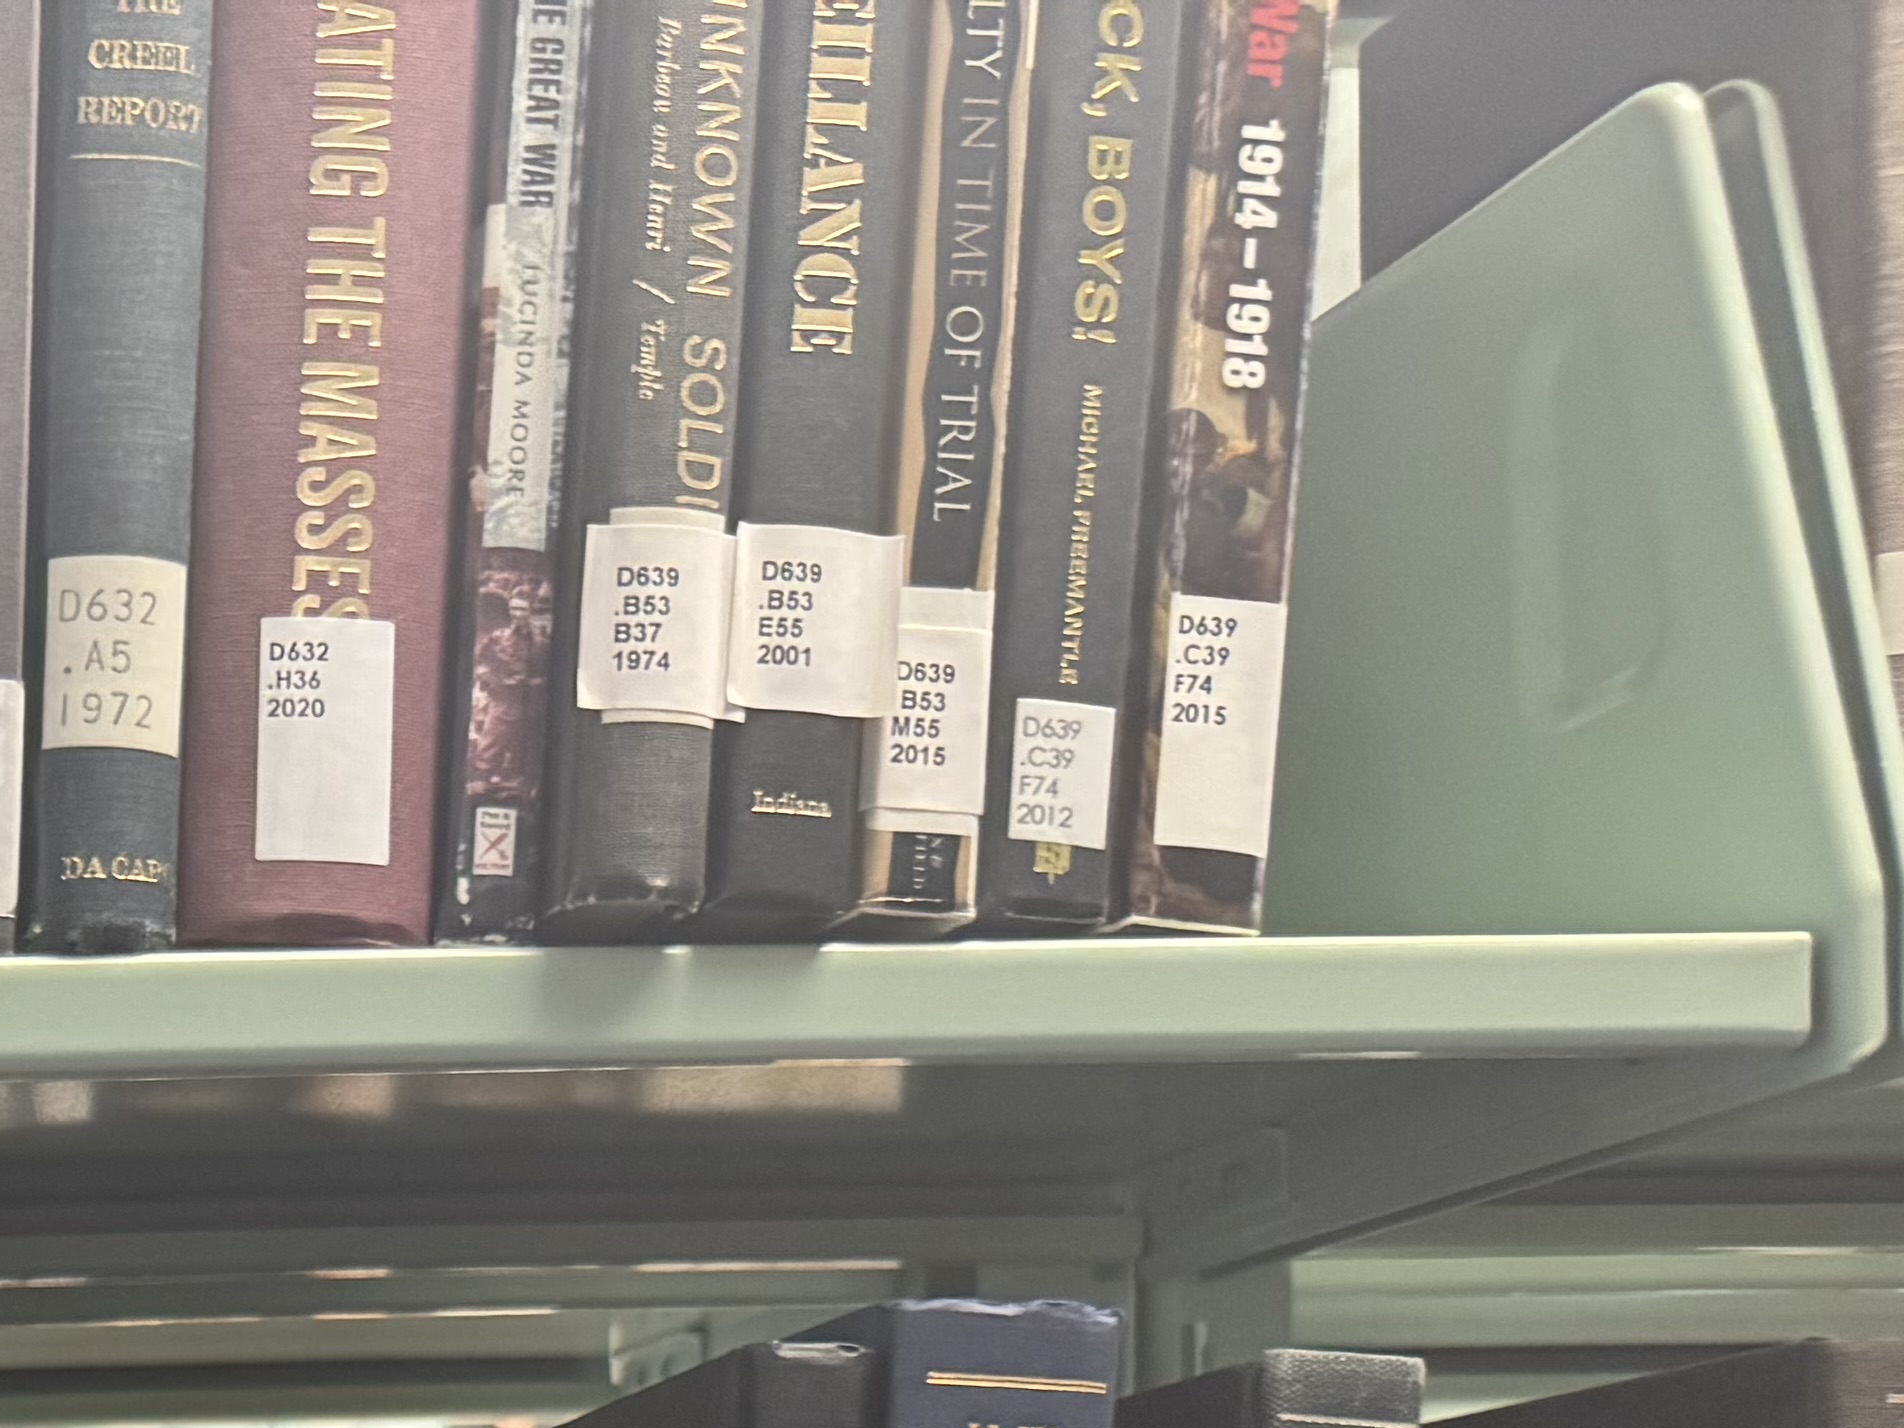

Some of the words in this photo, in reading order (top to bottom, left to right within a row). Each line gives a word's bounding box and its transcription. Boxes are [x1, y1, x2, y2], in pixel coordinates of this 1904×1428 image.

[960, 100, 995, 148] IN
[950, 170, 991, 285] TIME
[942, 307, 986, 371] OF
[933, 387, 976, 522] TRIAL
[618, 566, 679, 588] D639
[614, 595, 670, 617] .B53
[614, 621, 661, 643] B37
[612, 650, 670, 672] 1974
